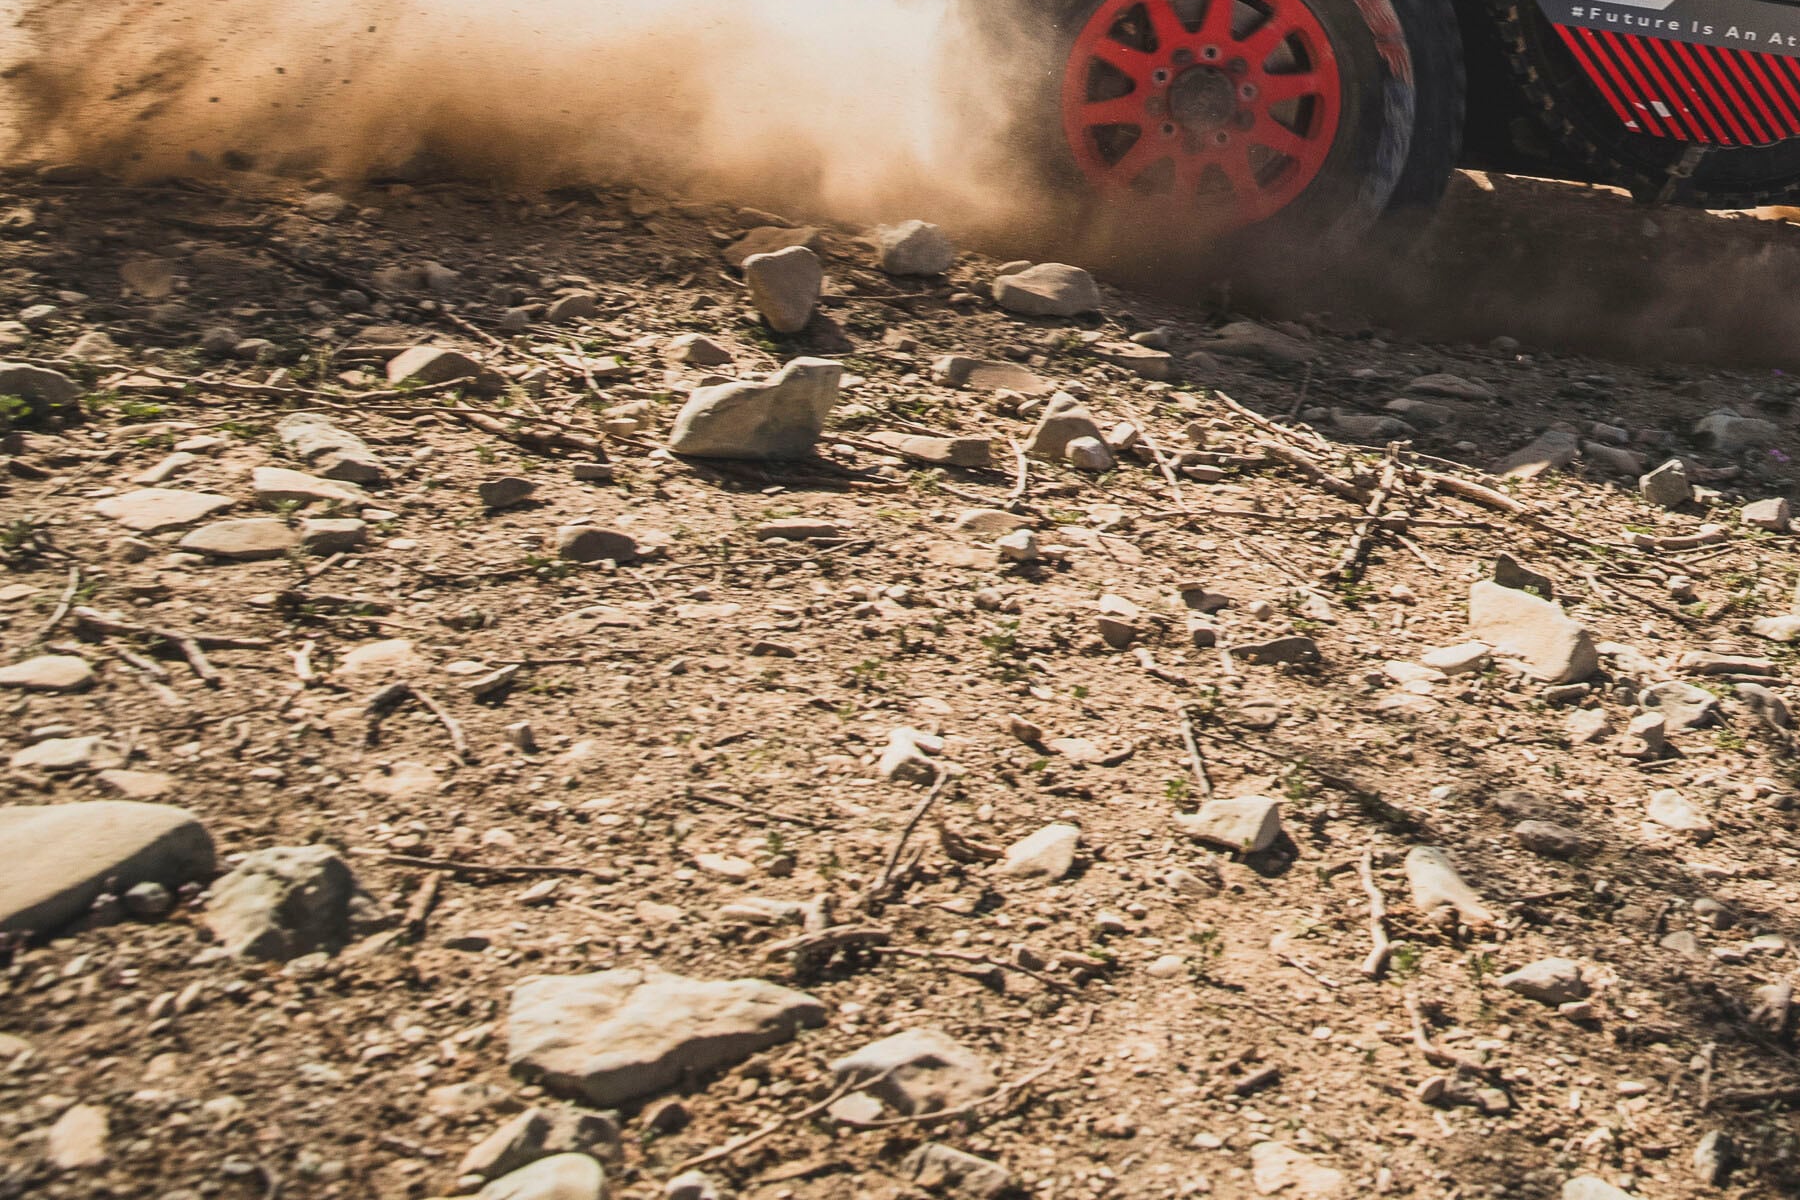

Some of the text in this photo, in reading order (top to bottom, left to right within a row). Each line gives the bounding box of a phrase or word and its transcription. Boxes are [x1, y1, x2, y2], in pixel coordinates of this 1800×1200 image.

[1571, 5, 1680, 31] #Future
[1692, 20, 1713, 35] Is
[1725, 26, 1757, 41] An
